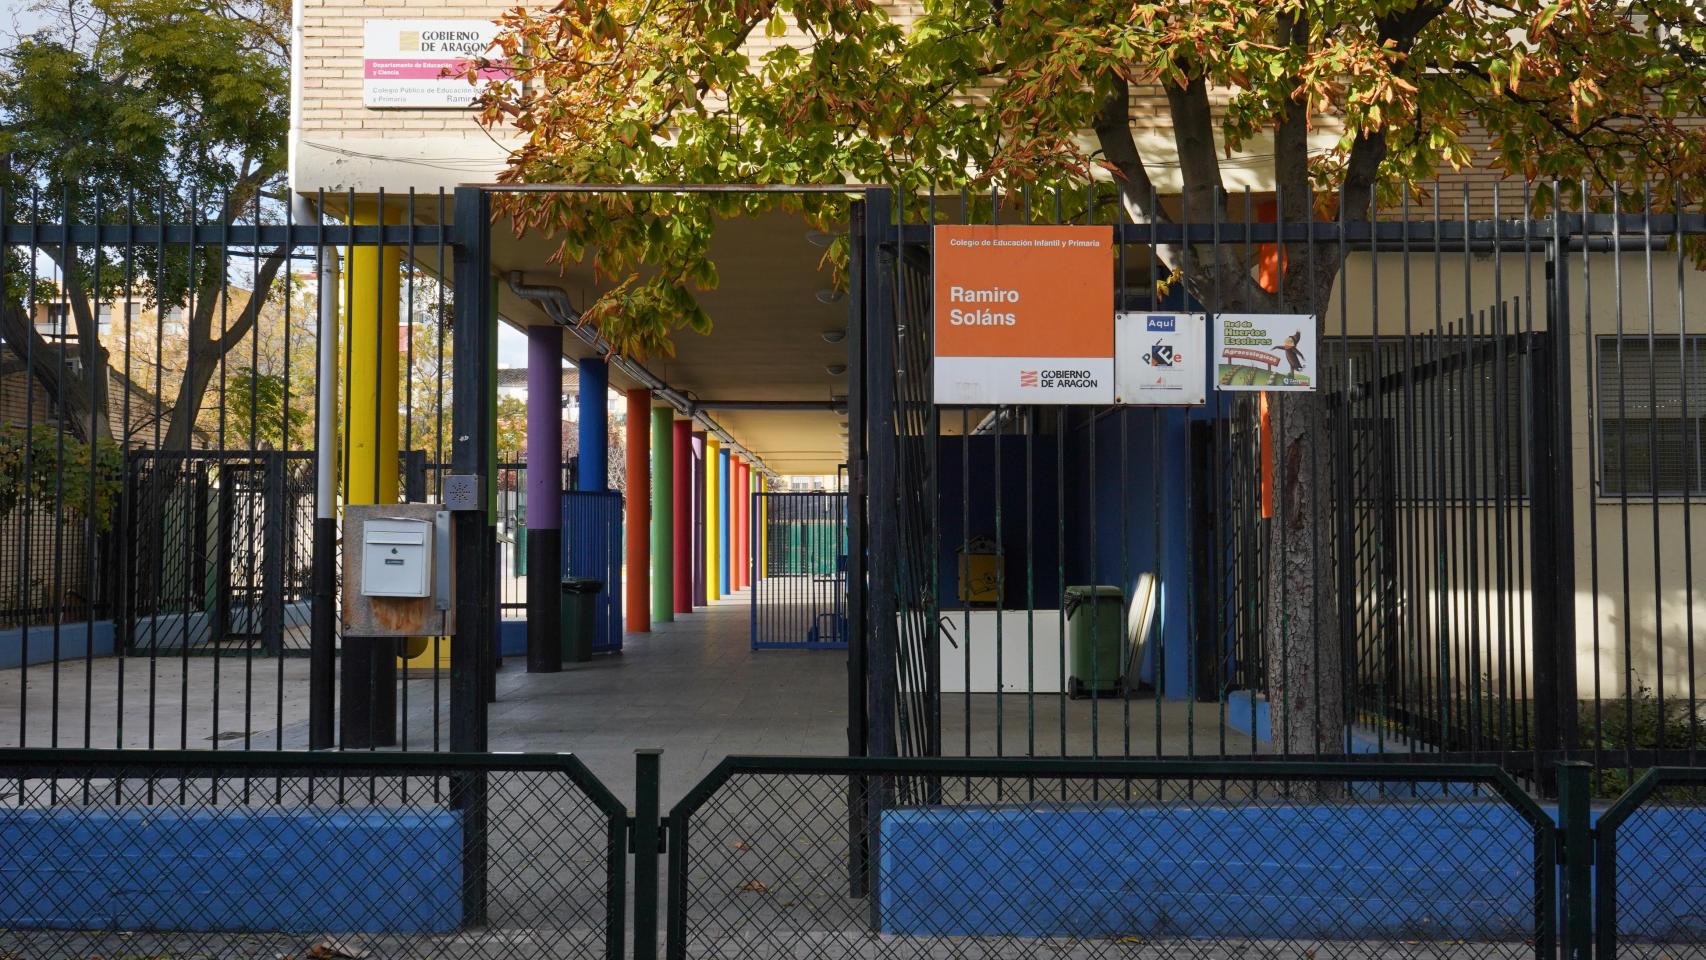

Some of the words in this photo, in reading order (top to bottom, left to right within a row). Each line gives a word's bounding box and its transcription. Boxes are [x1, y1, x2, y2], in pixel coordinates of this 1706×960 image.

[422, 31, 480, 41] GOBIERNO
[421, 42, 436, 52] DE
[447, 95, 476, 103] Ramir
[950, 238, 980, 248] Colegio
[981, 239, 992, 247] de
[993, 238, 1033, 247] Educación
[1034, 239, 1060, 247] Infantil
[1061, 240, 1067, 248] y
[1068, 239, 1100, 248] Primaria
[950, 286, 1020, 303] Ramiro
[950, 308, 1016, 326] Soláns
[1148, 319, 1174, 329] Aquí
[1224, 320, 1240, 328] Red
[1241, 320, 1253, 328] de
[1224, 328, 1267, 336] Huertos
[1224, 336, 1272, 345] Escolares
[1041, 370, 1091, 379] GOBIERNO
[1041, 379, 1054, 388] DE
[1057, 379, 1098, 388] ARAGON
